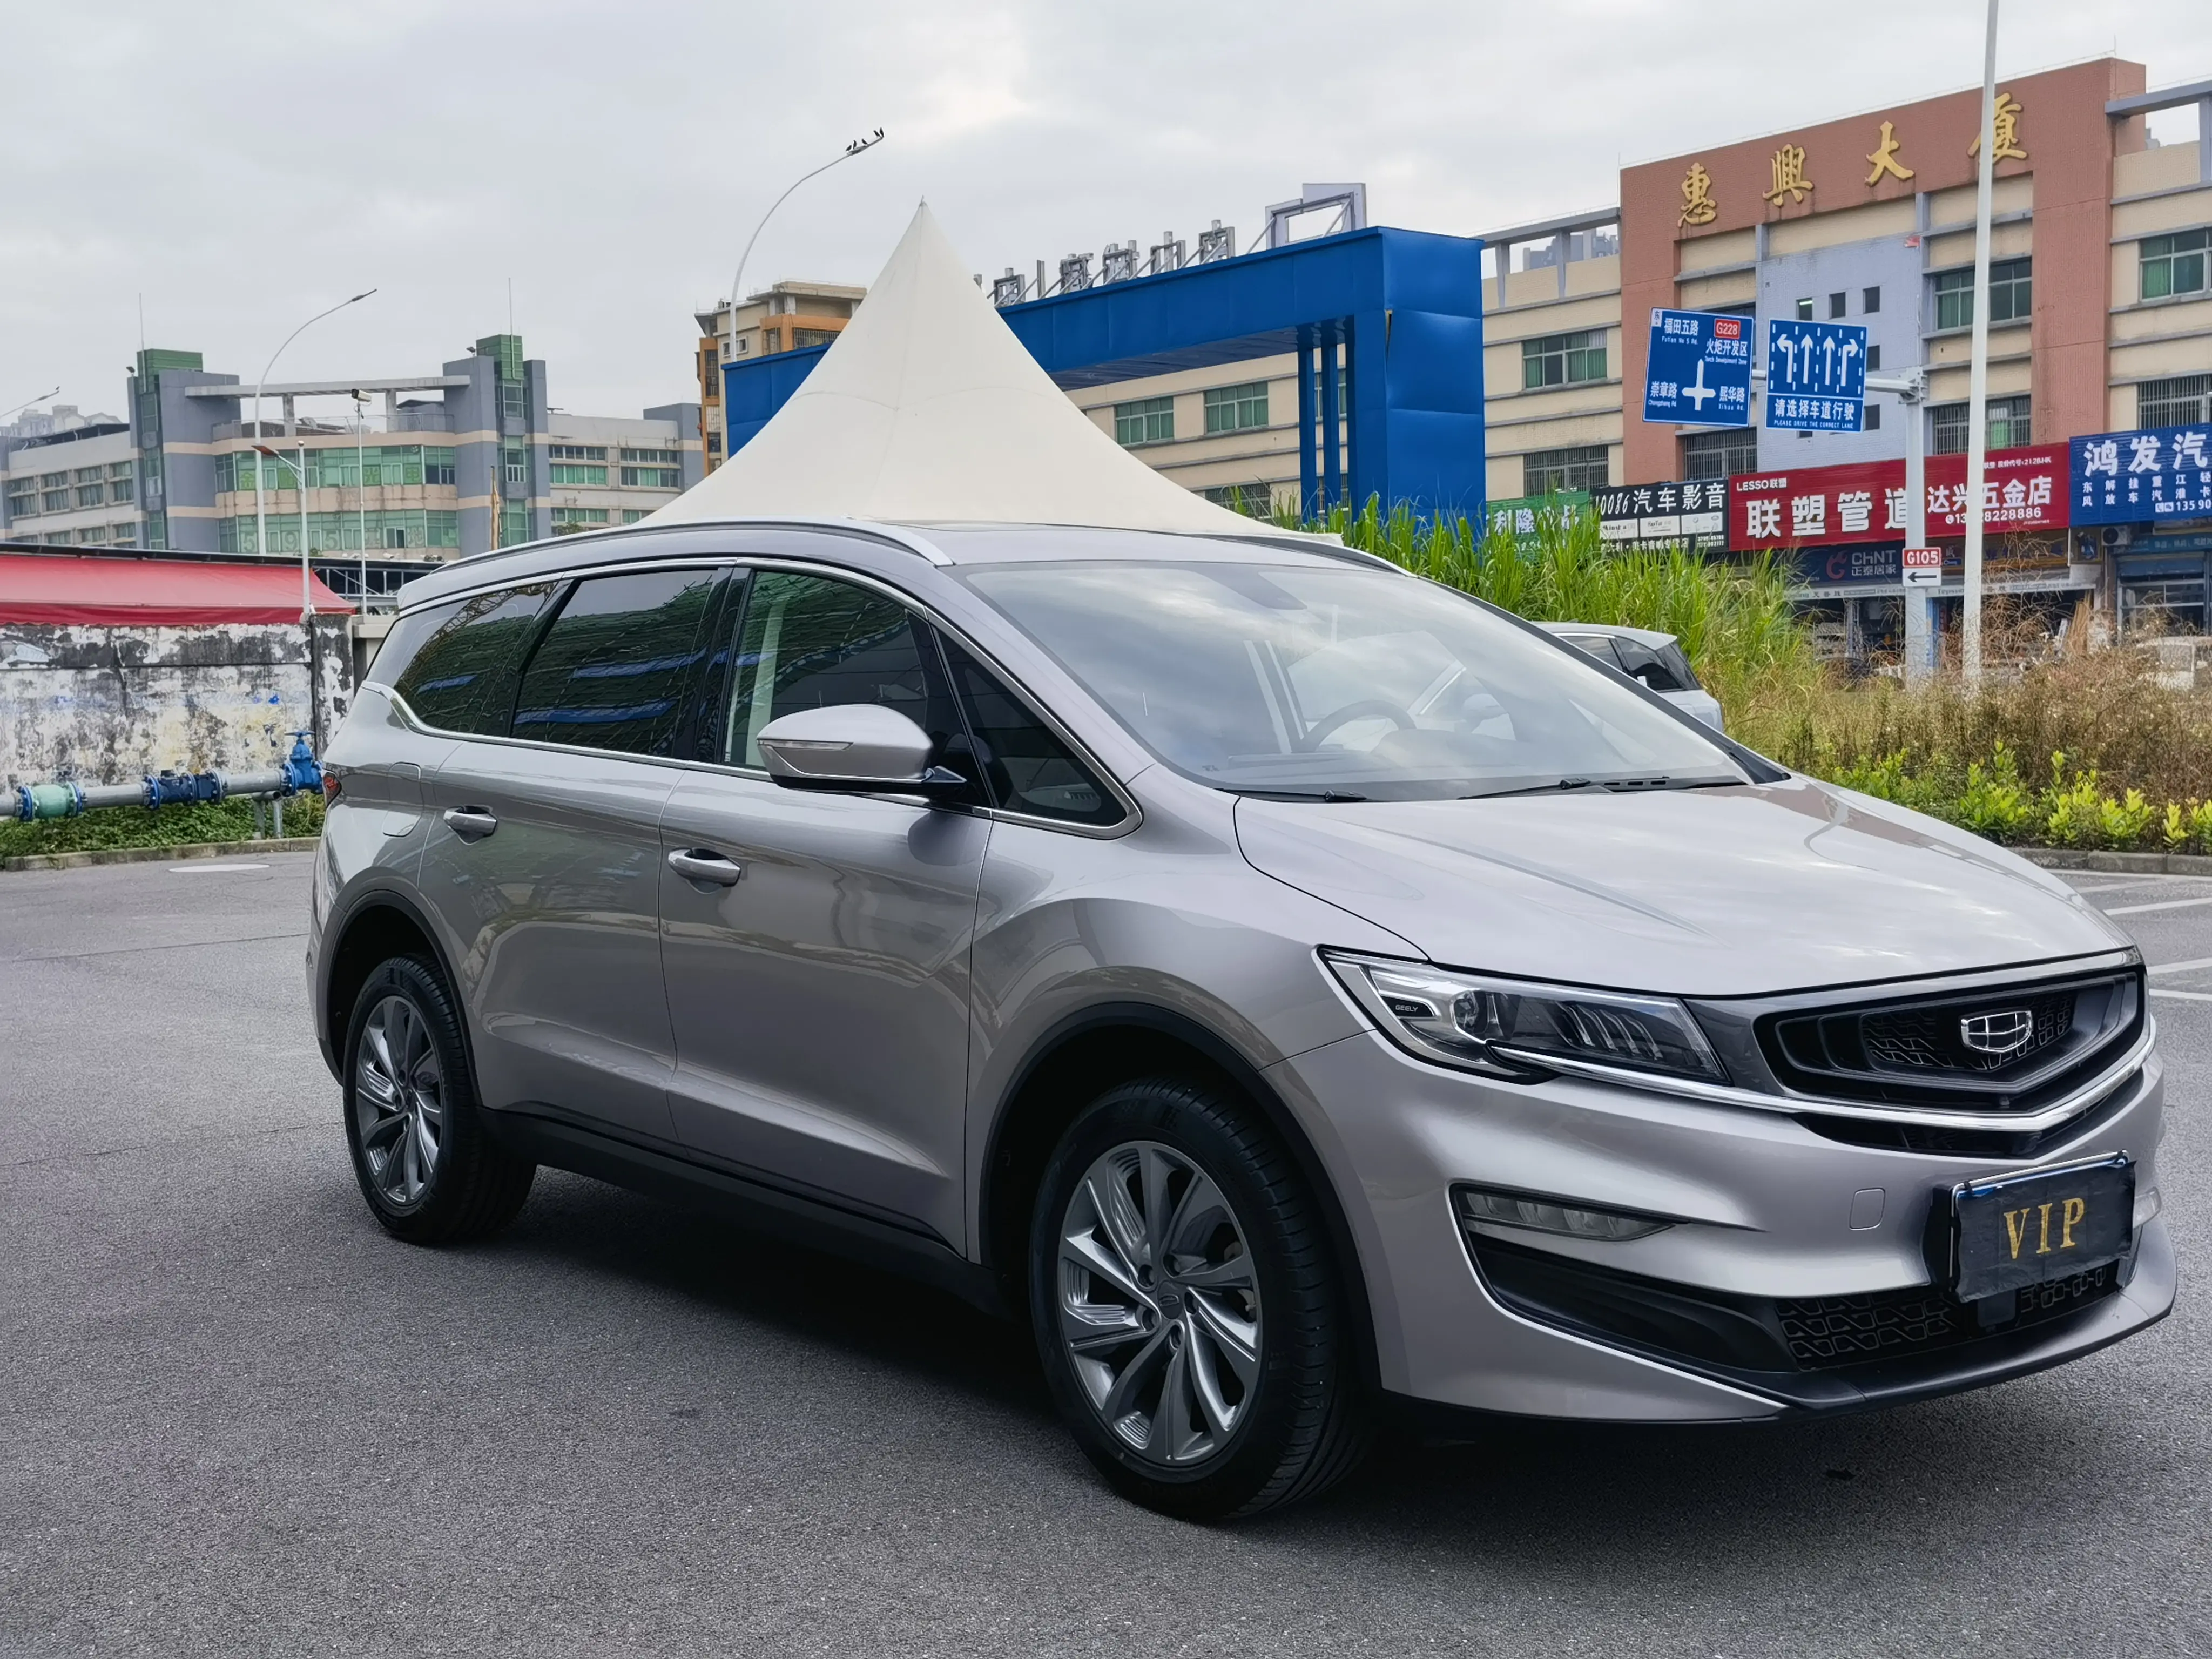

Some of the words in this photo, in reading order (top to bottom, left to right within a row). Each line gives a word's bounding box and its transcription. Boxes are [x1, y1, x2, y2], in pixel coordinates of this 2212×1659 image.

[1664, 317, 1699, 336] 福田五路
[1716, 322, 1738, 335] G228
[1705, 338, 1748, 356] 火炬开发区
[1775, 398, 1855, 421] 请选择车道行驶
[2083, 431, 2208, 477] 鸿发汽
[1927, 476, 2052, 514] 达兴五金店
[1746, 487, 1907, 538] 联塑管道
[2176, 500, 2195, 511] 135
[1955, 507, 2041, 523] 138228886
[1906, 550, 1939, 565] G105
[1395, 1004, 1419, 1013] GEELY
[2003, 1197, 2085, 1260] VIP
